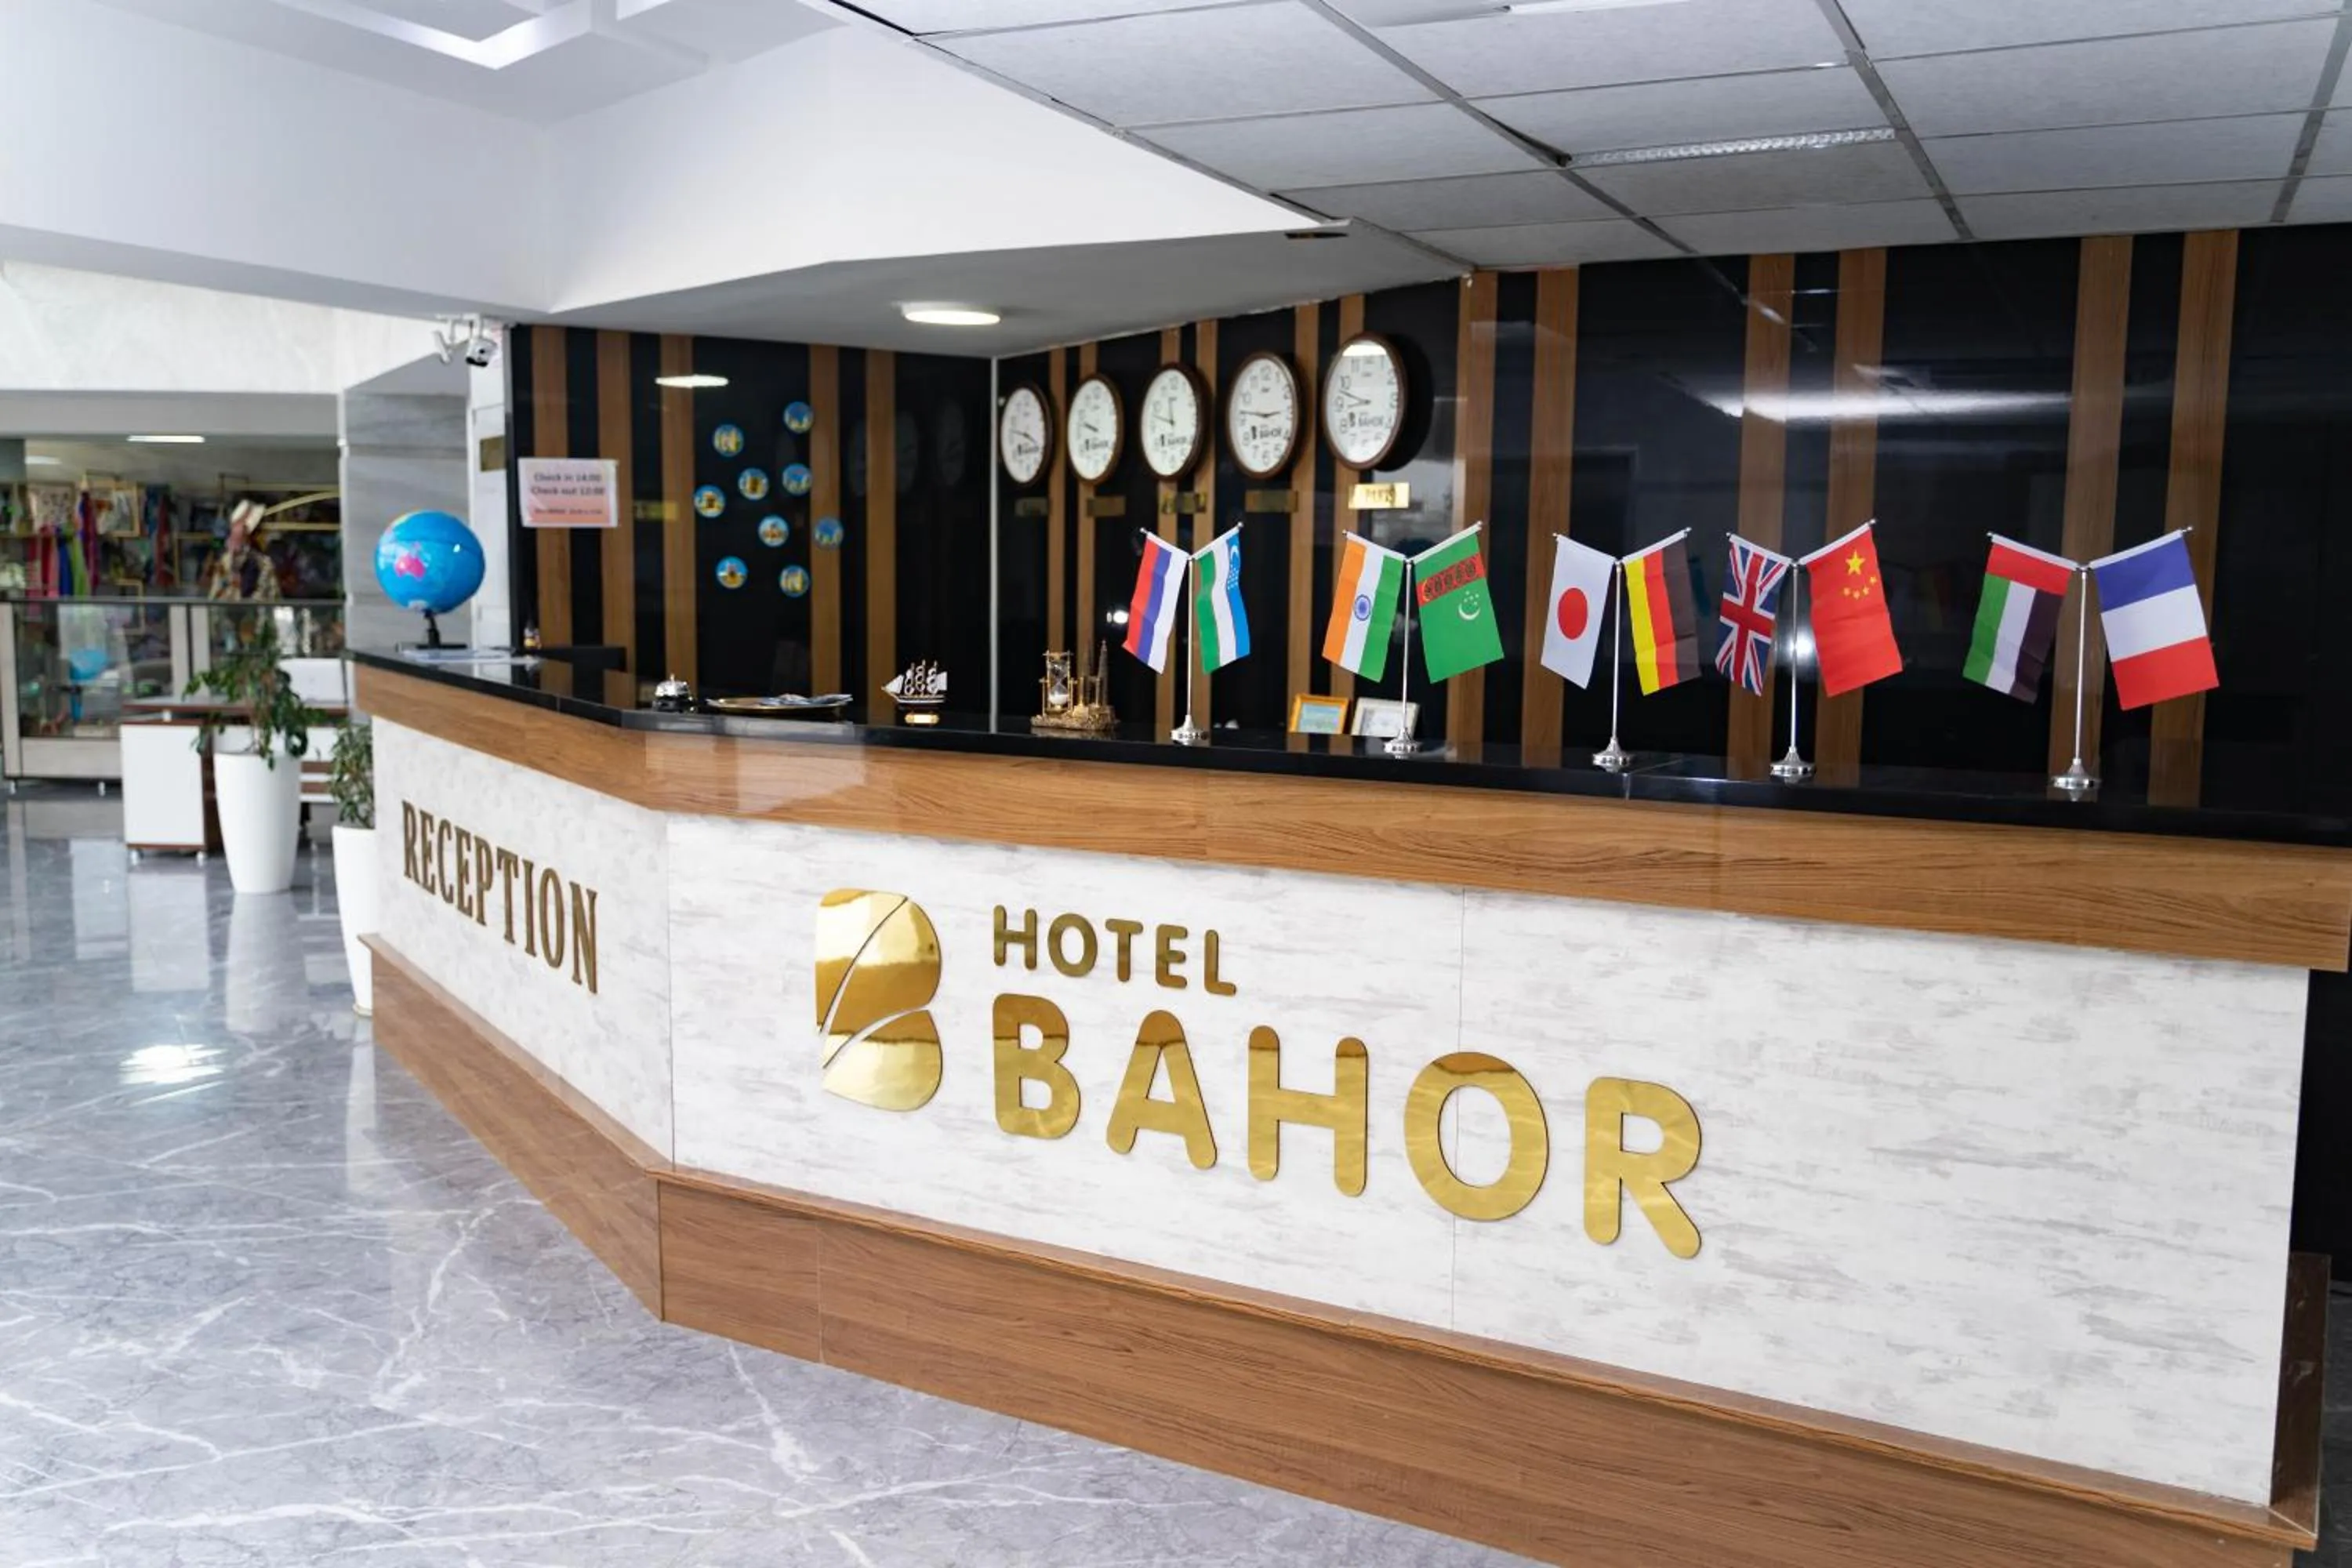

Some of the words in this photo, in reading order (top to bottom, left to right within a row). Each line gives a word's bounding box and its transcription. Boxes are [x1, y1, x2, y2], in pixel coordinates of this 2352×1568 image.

[401, 800, 598, 994] RECEPTION
[993, 905, 1236, 997] HOTEL
[992, 993, 1703, 1259] BAHOR
